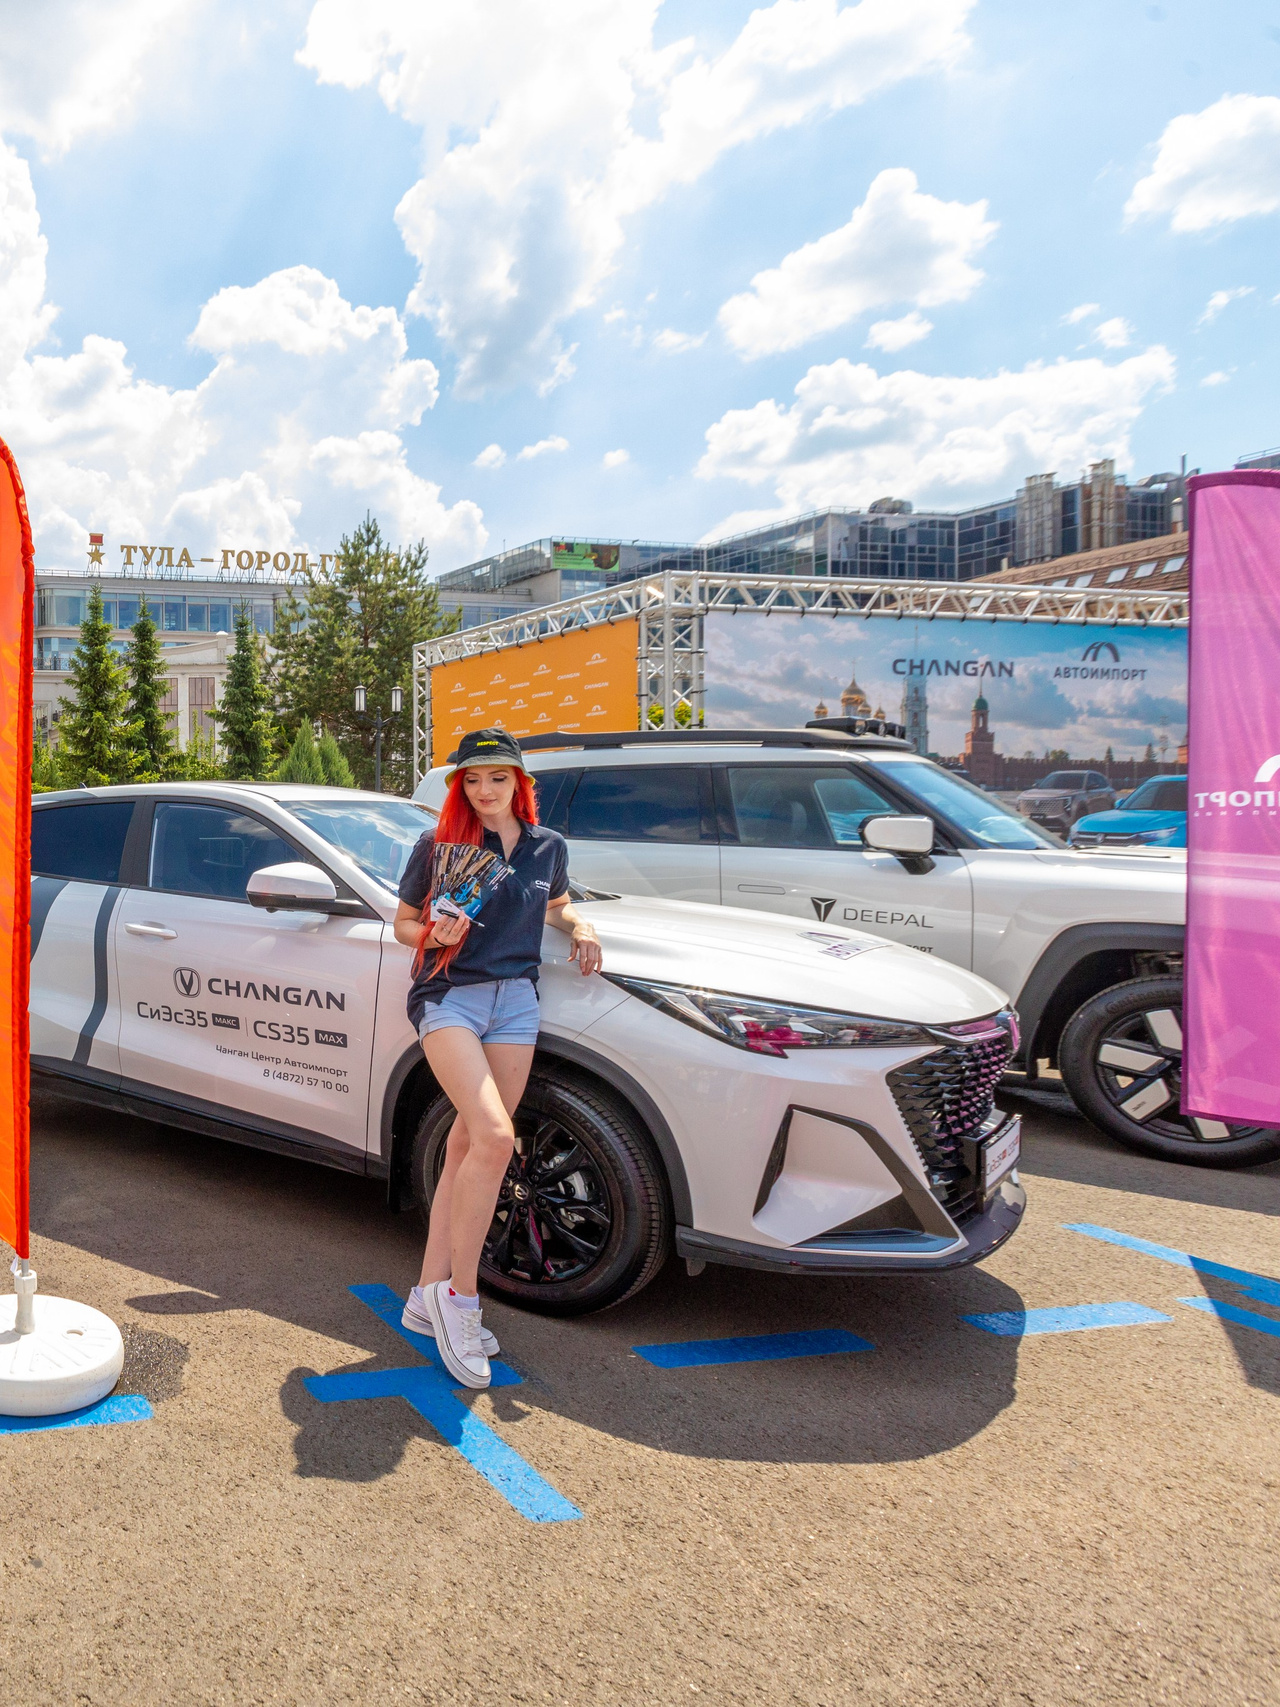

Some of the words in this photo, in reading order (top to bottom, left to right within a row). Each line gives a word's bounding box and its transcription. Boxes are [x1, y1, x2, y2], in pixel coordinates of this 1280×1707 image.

[120, 545, 194, 568] ТУЛА
[892, 659, 1014, 678] CHANGAN
[1053, 666, 1147, 681] АВТОИМПОРТ
[843, 908, 934, 928] DEEPAL
[207, 978, 345, 1011] CHANGAN
[137, 1002, 208, 1028] СиЭс35
[215, 1016, 237, 1026] МАКС
[253, 1020, 310, 1046] CS35
[318, 1033, 344, 1045] MAX
[216, 1044, 249, 1058] Чанган
[251, 1051, 282, 1065] Центр
[284, 1057, 348, 1077] Автоимпорт
[263, 1069, 270, 1077] 8
[272, 1070, 304, 1085] (4872)
[307, 1077, 319, 1087] 57
[322, 1080, 333, 1090] 10
[335, 1083, 349, 1093] 00
